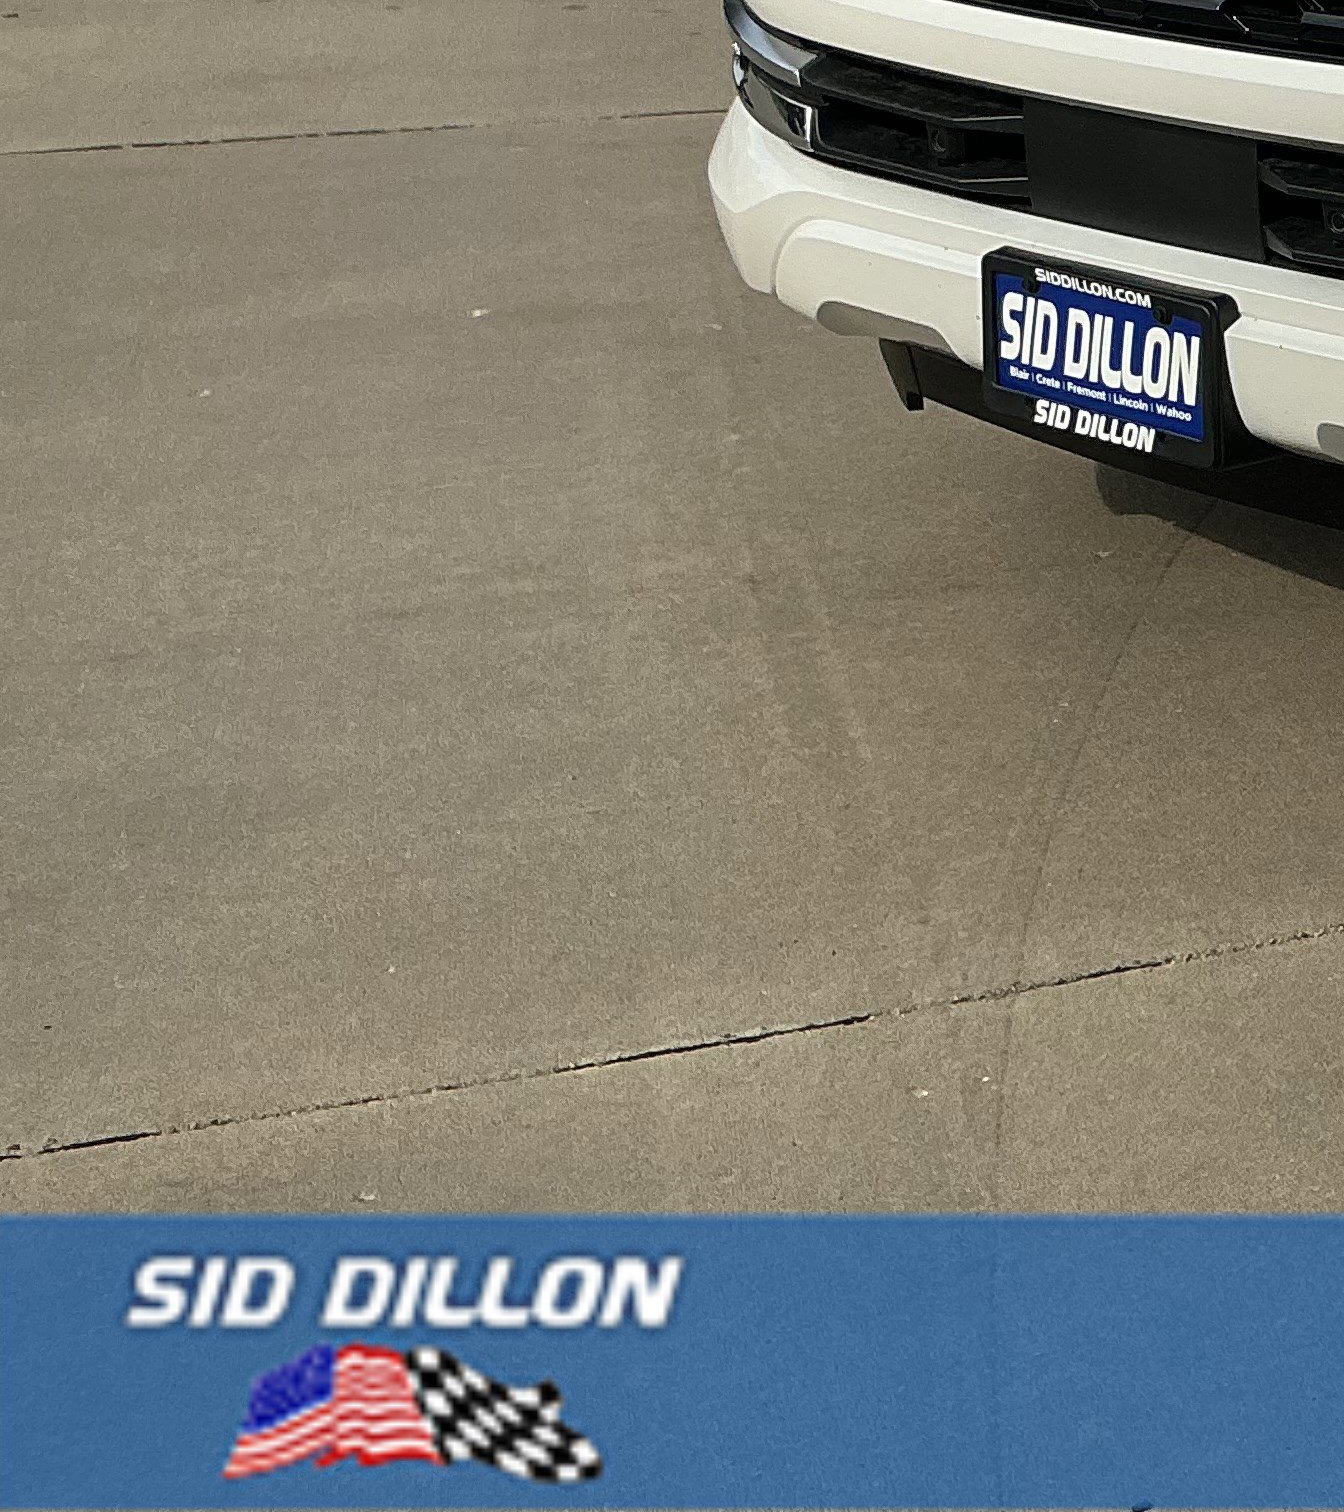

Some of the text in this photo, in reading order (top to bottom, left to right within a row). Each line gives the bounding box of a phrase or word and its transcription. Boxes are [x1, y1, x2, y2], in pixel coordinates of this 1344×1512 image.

[1034, 267, 1152, 309] SIDDILLON.COM
[1000, 291, 1201, 407] SID DILLON
[1066, 381, 1107, 402] Fremont
[1113, 392, 1149, 412] Lincoln
[1155, 404, 1192, 422] Wahoo
[1033, 399, 1156, 453] SID DILLON
